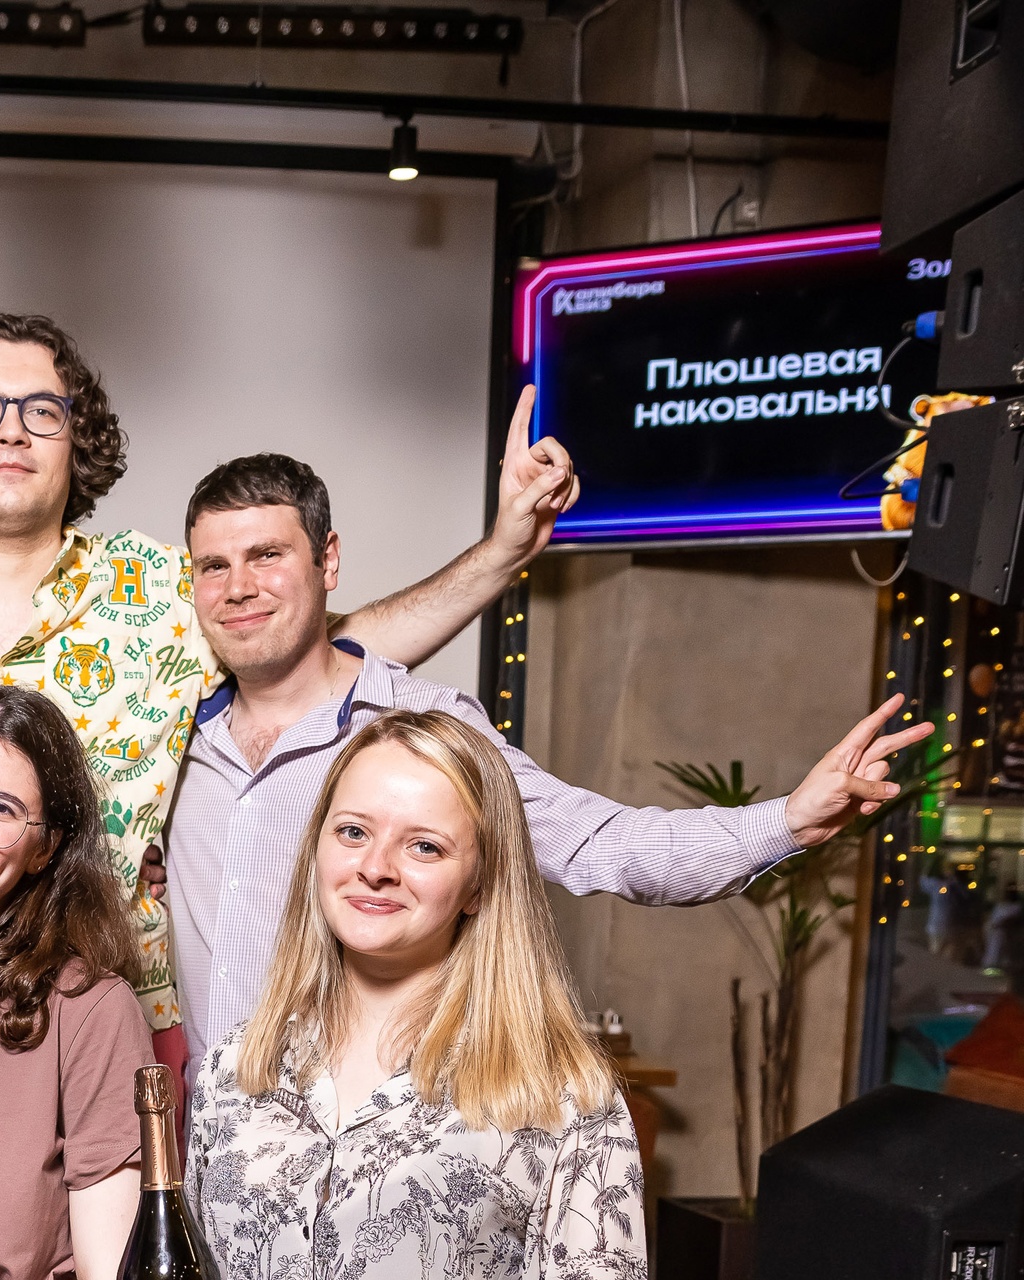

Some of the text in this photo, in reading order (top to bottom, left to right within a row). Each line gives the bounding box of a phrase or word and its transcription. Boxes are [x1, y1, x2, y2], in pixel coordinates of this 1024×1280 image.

[646, 347, 882, 391] Плюшевая
[634, 384, 892, 428] наковальня
[151, 579, 171, 588] 1952
[124, 600, 172, 628] SCHOOL
[123, 671, 145, 680] ESTD
[110, 755, 157, 783] SCHOOL
